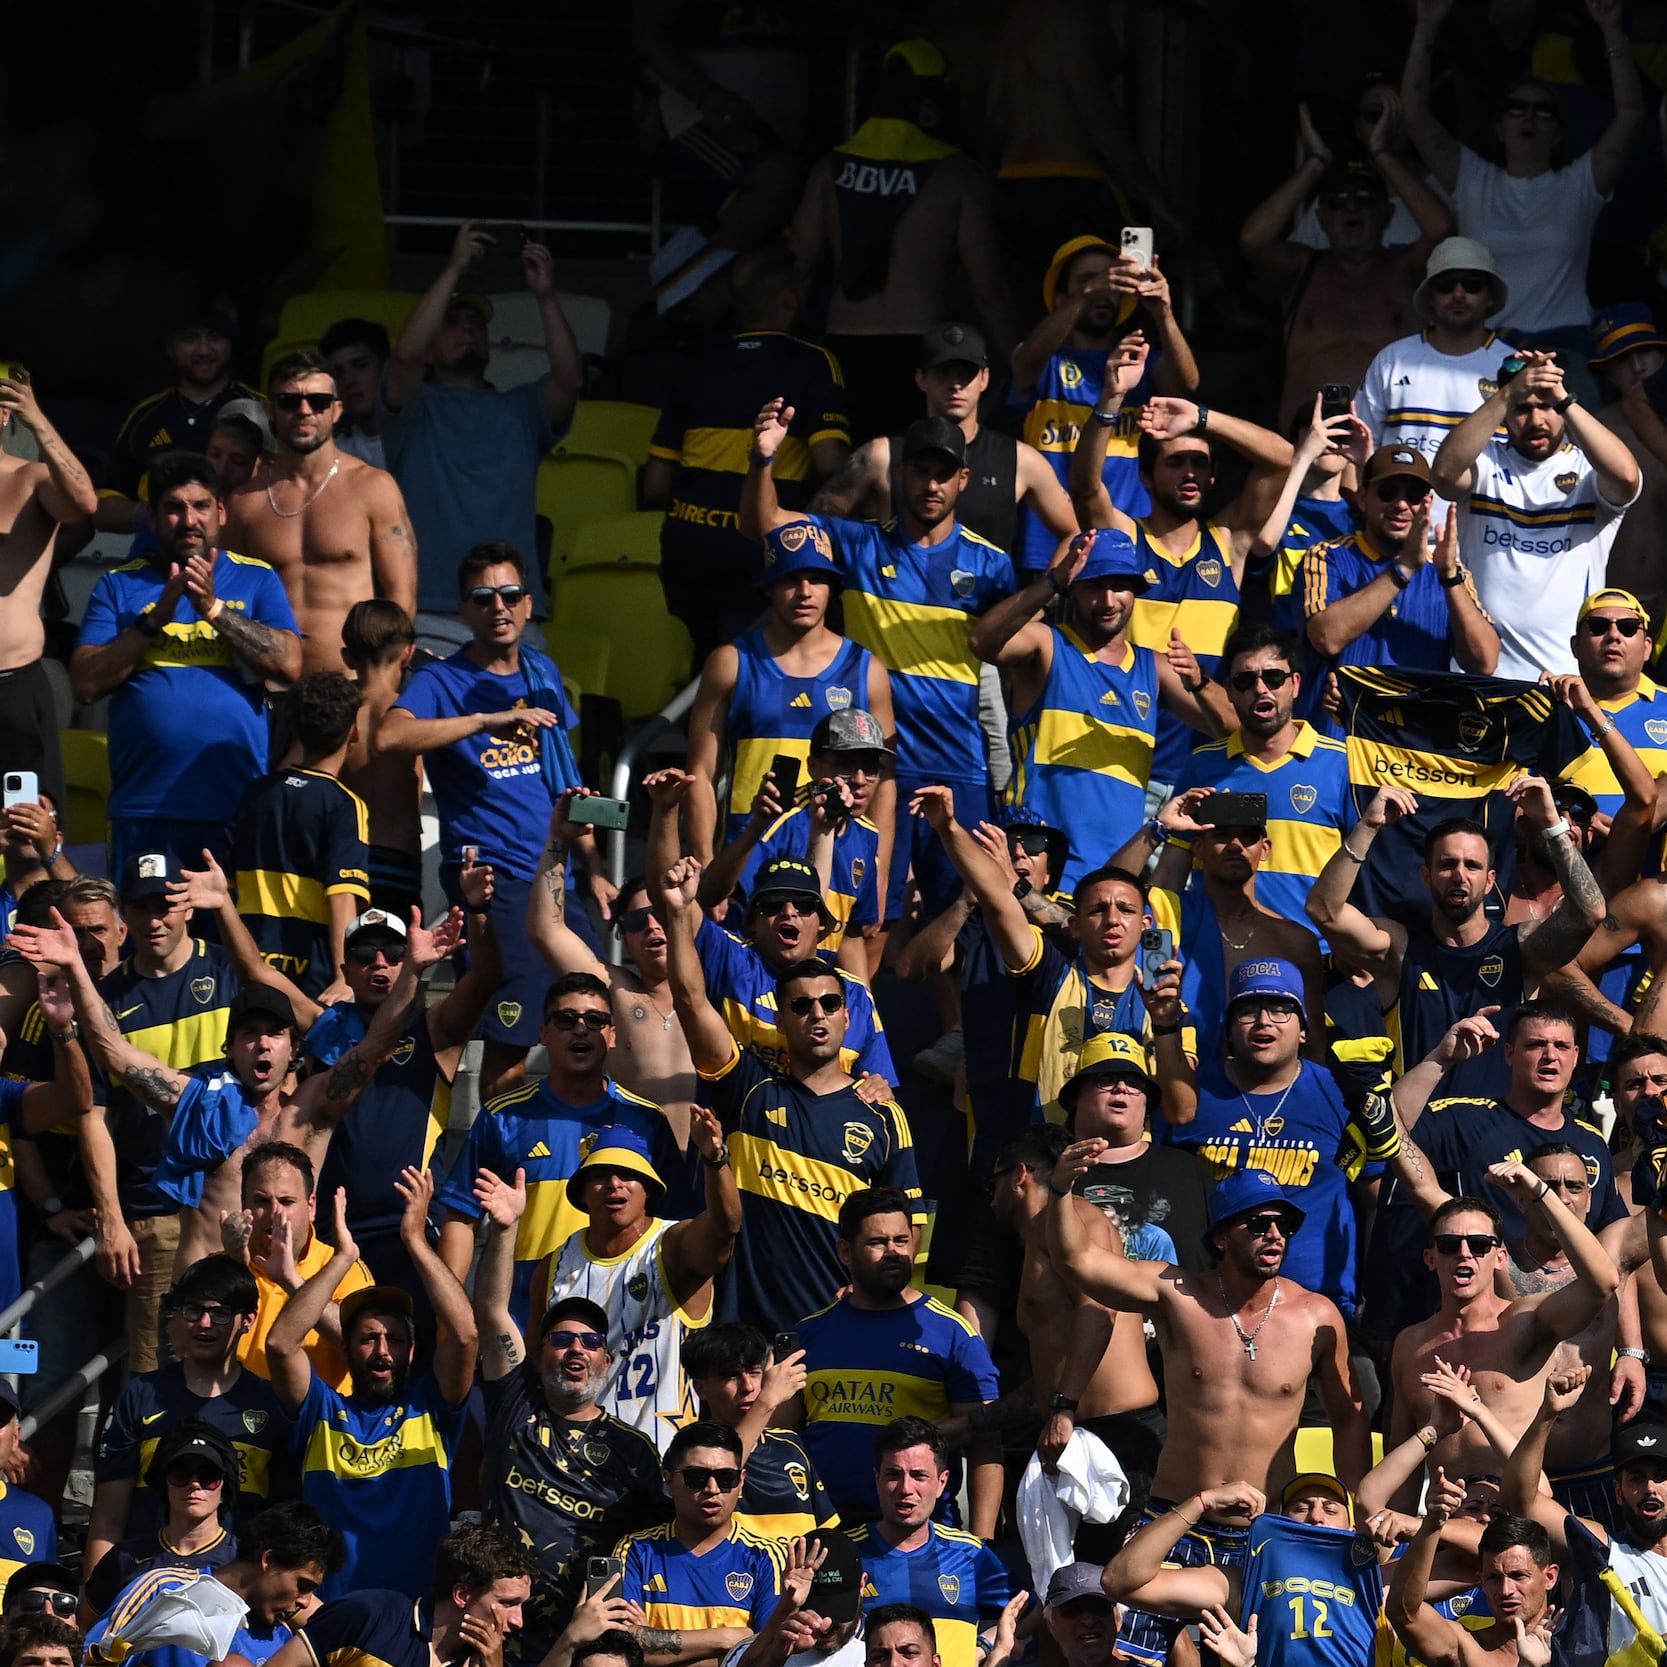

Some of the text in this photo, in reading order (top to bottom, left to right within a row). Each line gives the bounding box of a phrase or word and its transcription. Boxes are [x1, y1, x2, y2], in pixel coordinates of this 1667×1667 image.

[837, 161, 918, 195] BBVA
[1483, 525, 1572, 556] betsson
[1374, 755, 1478, 787] betsson
[1240, 963, 1281, 981] BOCA
[1479, 963, 1501, 974] CABJ
[1108, 1039, 1131, 1053] 12
[757, 1157, 849, 1205] betsson
[617, 1357, 658, 1398] 12
[812, 1380, 895, 1405] QATAR
[830, 1401, 893, 1417] AIRWAYS
[504, 1466, 606, 1521] betsson
[728, 1579, 749, 1590] CABJ
[1262, 1578, 1356, 1607] boca
[1289, 1599, 1333, 1640] 12
